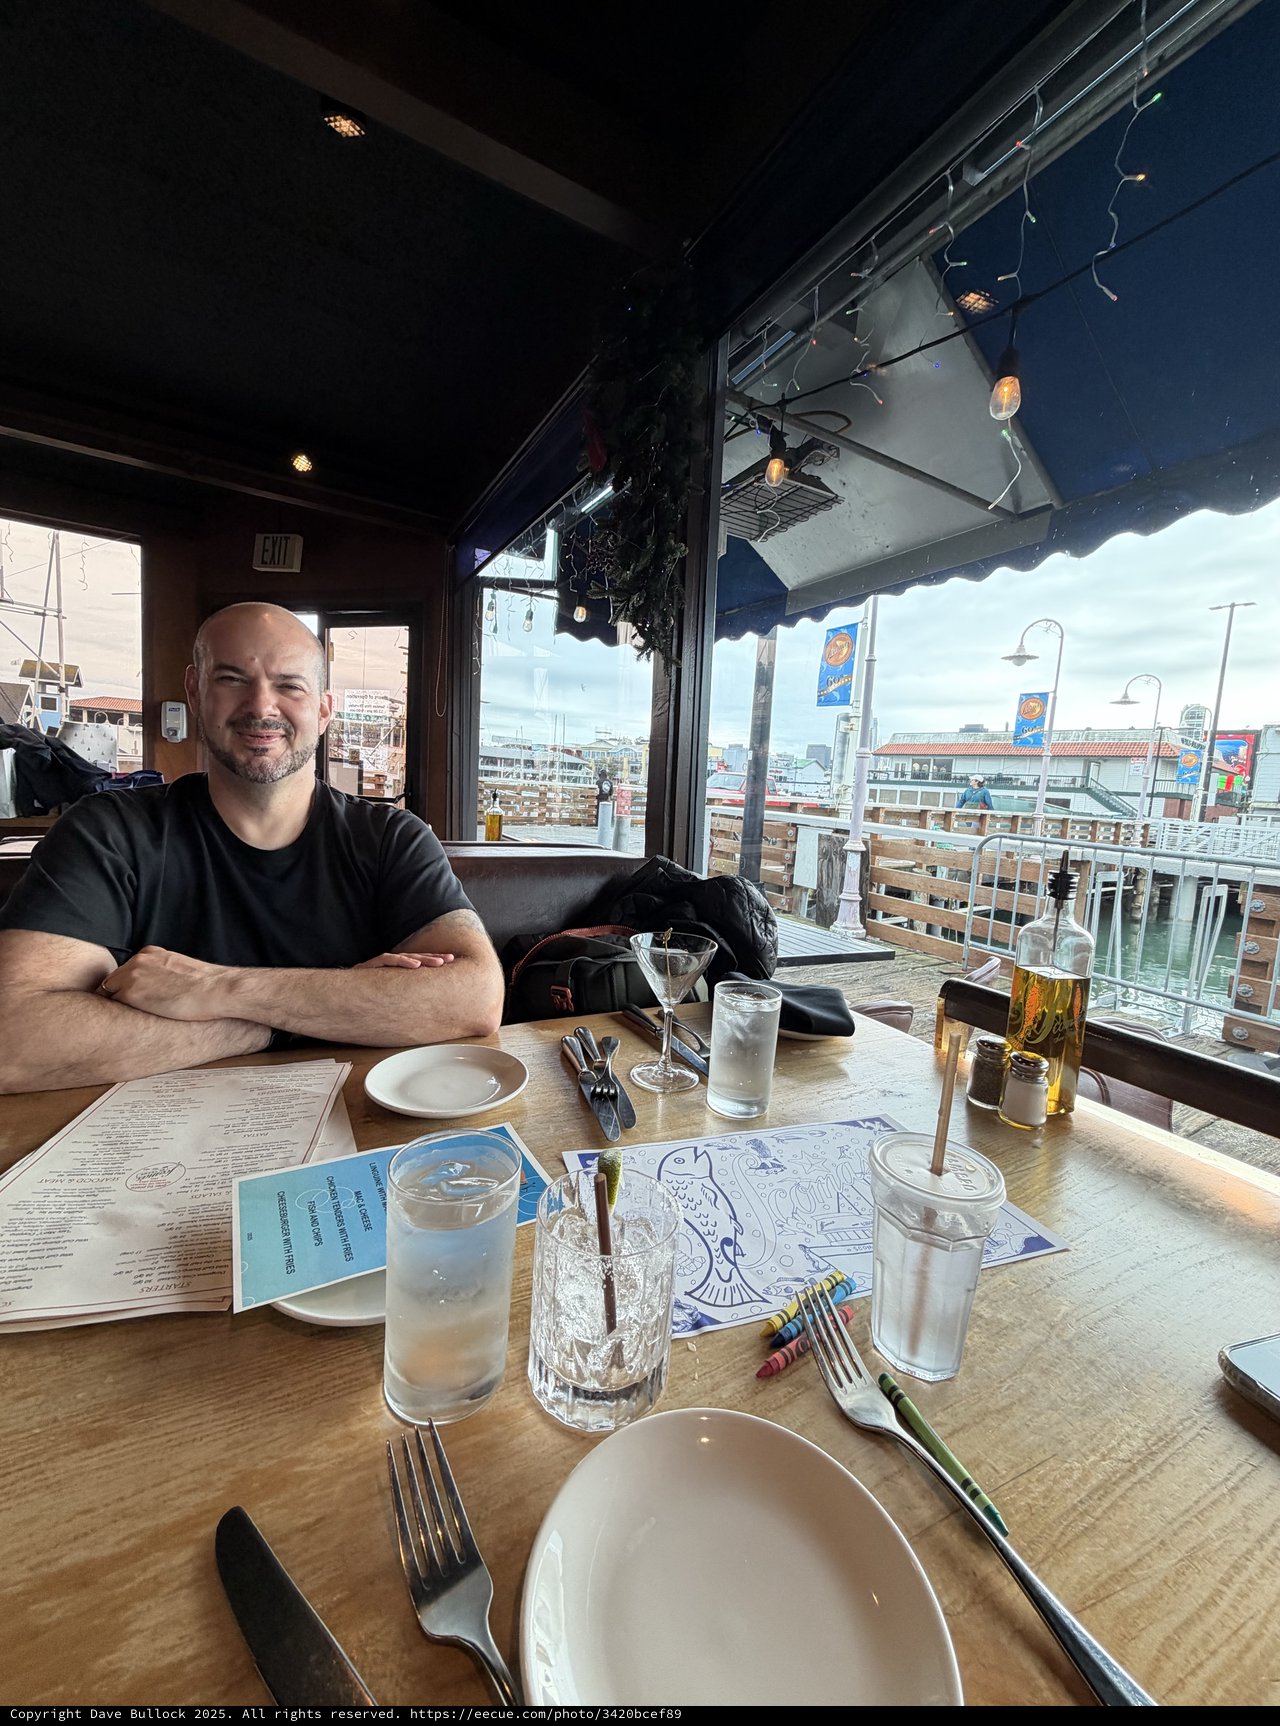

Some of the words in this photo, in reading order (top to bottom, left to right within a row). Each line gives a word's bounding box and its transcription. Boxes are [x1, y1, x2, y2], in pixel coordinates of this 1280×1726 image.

[261, 536, 290, 565] EXIT
[326, 1175, 339, 1200] CHICKEN
[369, 1162, 383, 1187] LINGUINE
[376, 1187, 388, 1202] WITH
[277, 1190, 290, 1237] CHEESEBURGER
[307, 1200, 317, 1214] FISH
[331, 1200, 346, 1228] TENDERS
[354, 1190, 364, 1204] MAC
[360, 1208, 373, 1232] CHEESE
[310, 1214, 320, 1228] AND
[312, 1228, 324, 1247] CHIPS
[338, 1226, 349, 1243] WITH
[282, 1237, 293, 1254] WITH
[341, 1242, 354, 1263] FRIES
[284, 1254, 296, 1275] FRIES
[138, 1280, 192, 1294] STARTERS
